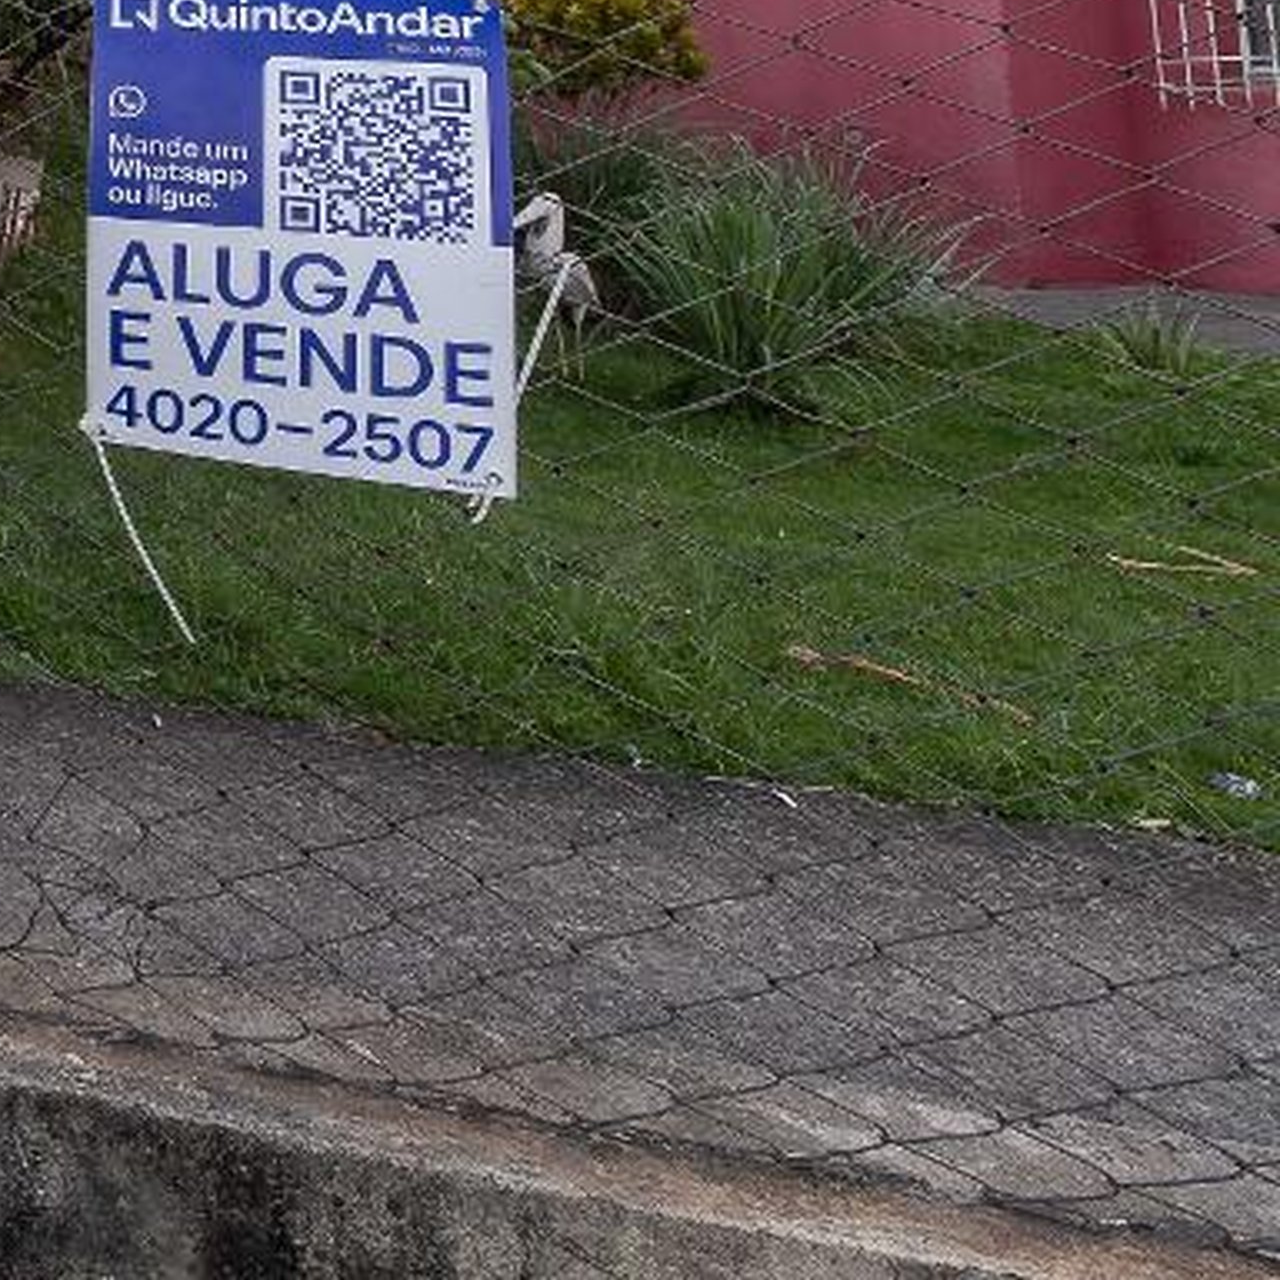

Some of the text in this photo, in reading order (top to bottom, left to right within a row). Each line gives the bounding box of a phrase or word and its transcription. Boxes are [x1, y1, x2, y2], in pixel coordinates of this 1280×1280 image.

[108, 132, 249, 161] Mande um
[108, 157, 248, 189] Whatsapp
[107, 185, 218, 211] ou ligue.
[105, 239, 421, 324] ALUGA
[109, 309, 494, 408] E VENDE
[105, 384, 495, 474] 4020-2507
